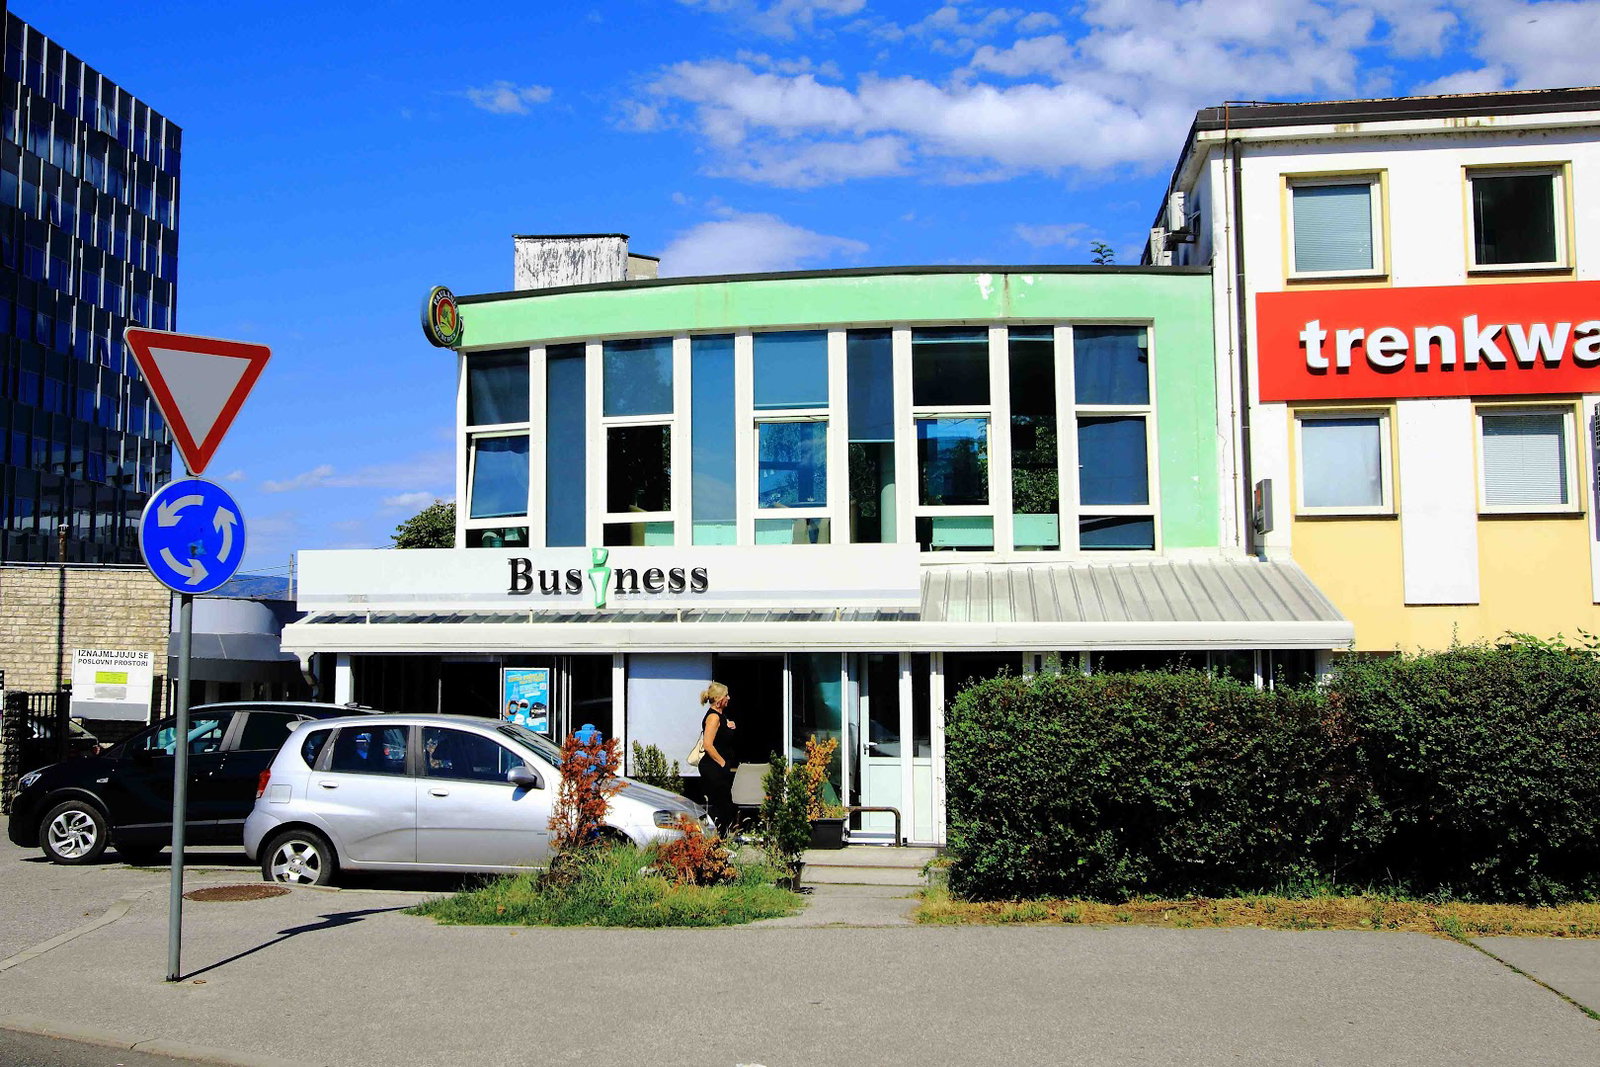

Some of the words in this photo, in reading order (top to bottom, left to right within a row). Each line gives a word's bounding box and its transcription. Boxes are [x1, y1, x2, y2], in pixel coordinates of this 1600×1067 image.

[1299, 314, 1600, 370] trenkwa
[507, 548, 709, 609] Business
[78, 649, 136, 659] IZNAJMLJUJU
